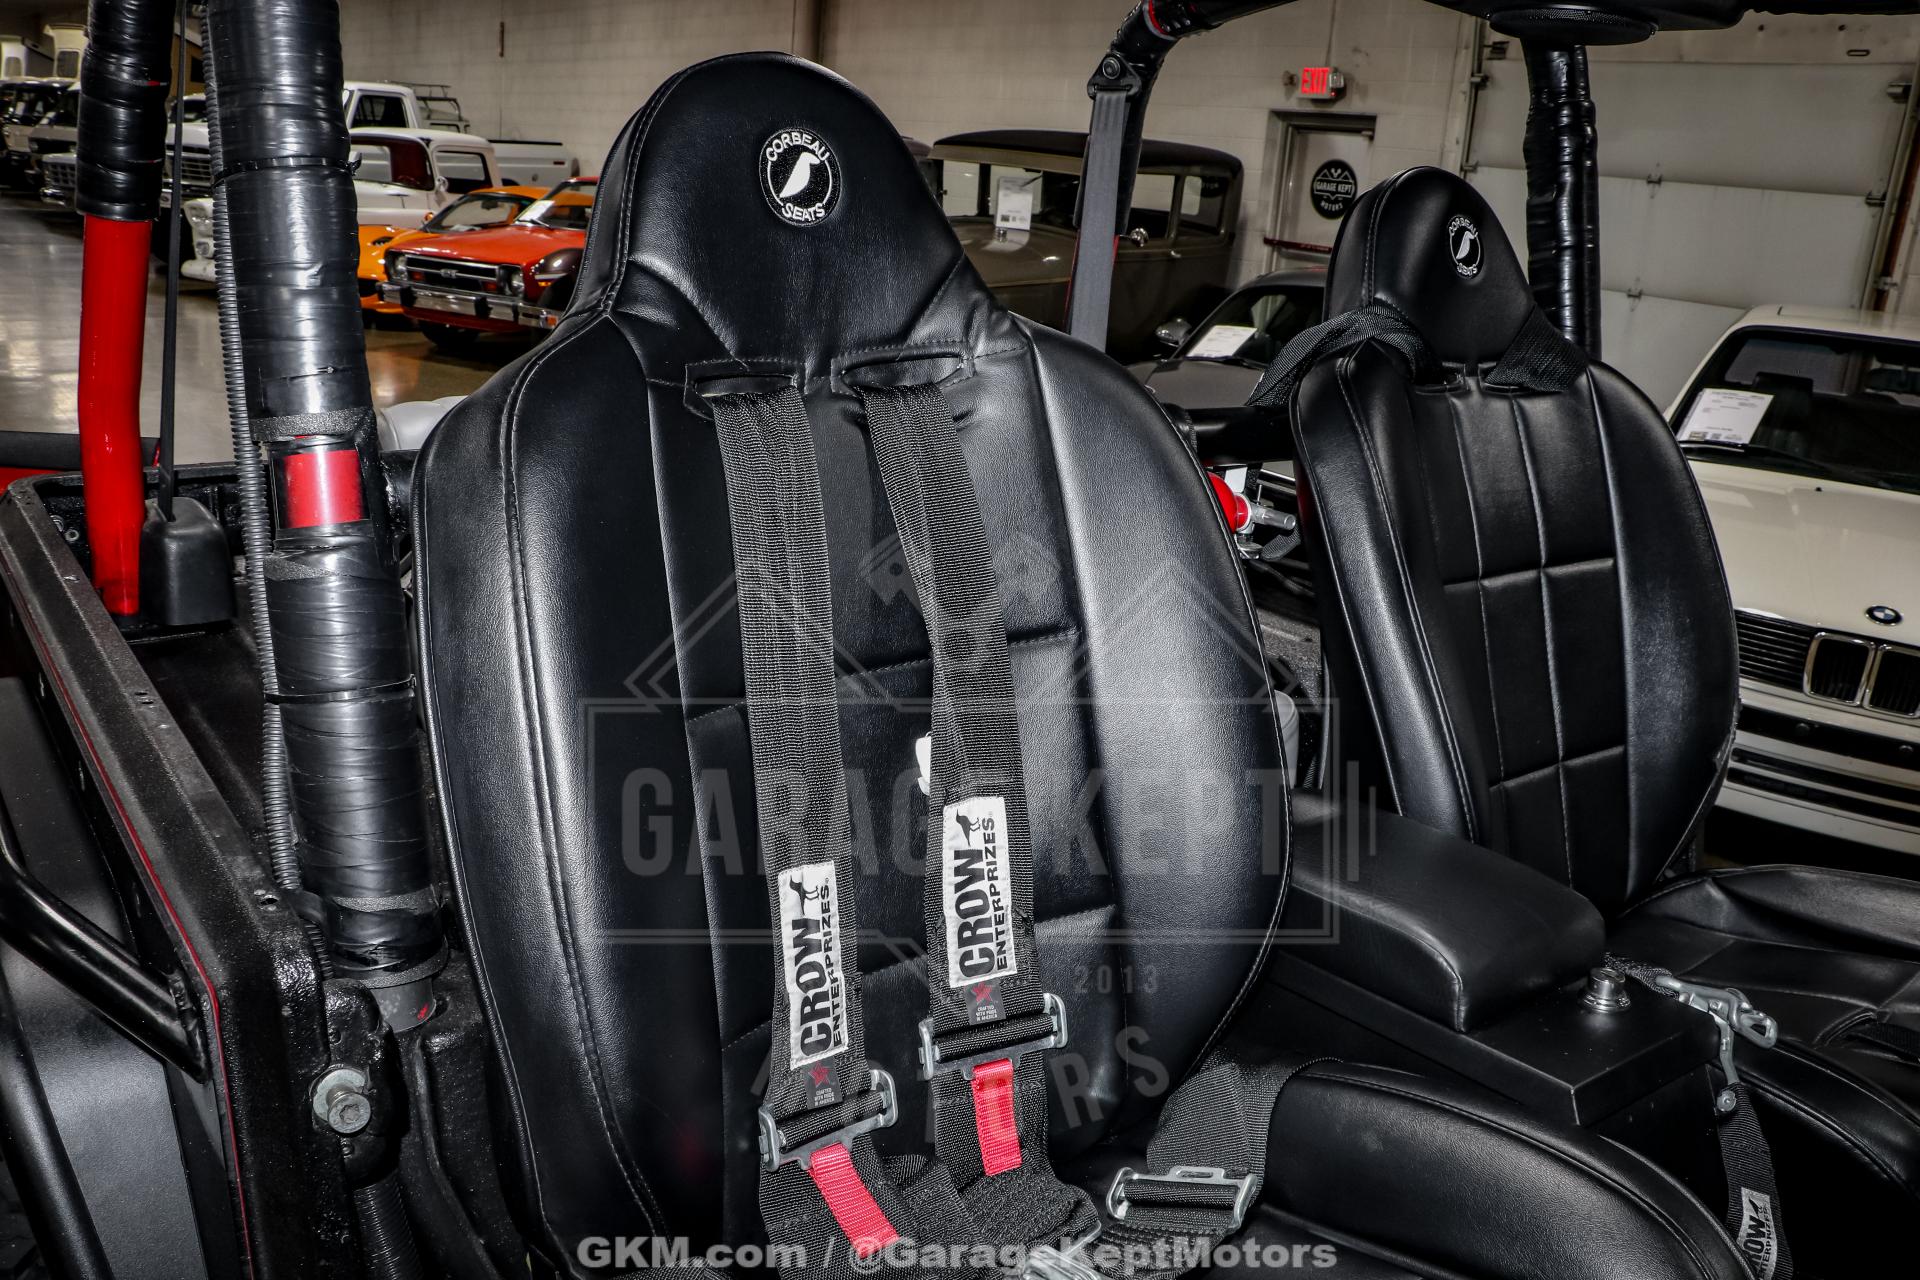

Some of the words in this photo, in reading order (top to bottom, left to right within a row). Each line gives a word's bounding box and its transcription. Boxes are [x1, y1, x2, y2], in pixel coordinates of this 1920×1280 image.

[1302, 67, 1329, 94] EXIT
[766, 132, 830, 161] CORBEAU
[1316, 181, 1337, 191] GARAGE
[1338, 184, 1352, 193] KEPT
[782, 203, 826, 221] SEATS
[1320, 200, 1343, 211] MOTORS
[1449, 217, 1479, 237] CORBEAU
[982, 817, 1008, 971] ENTERPRIZES
[953, 849, 996, 978] CROW
[820, 884, 844, 1048] ENTERPRIZES
[791, 918, 833, 1057] CROW
[1743, 1214, 1766, 1270] ROW
